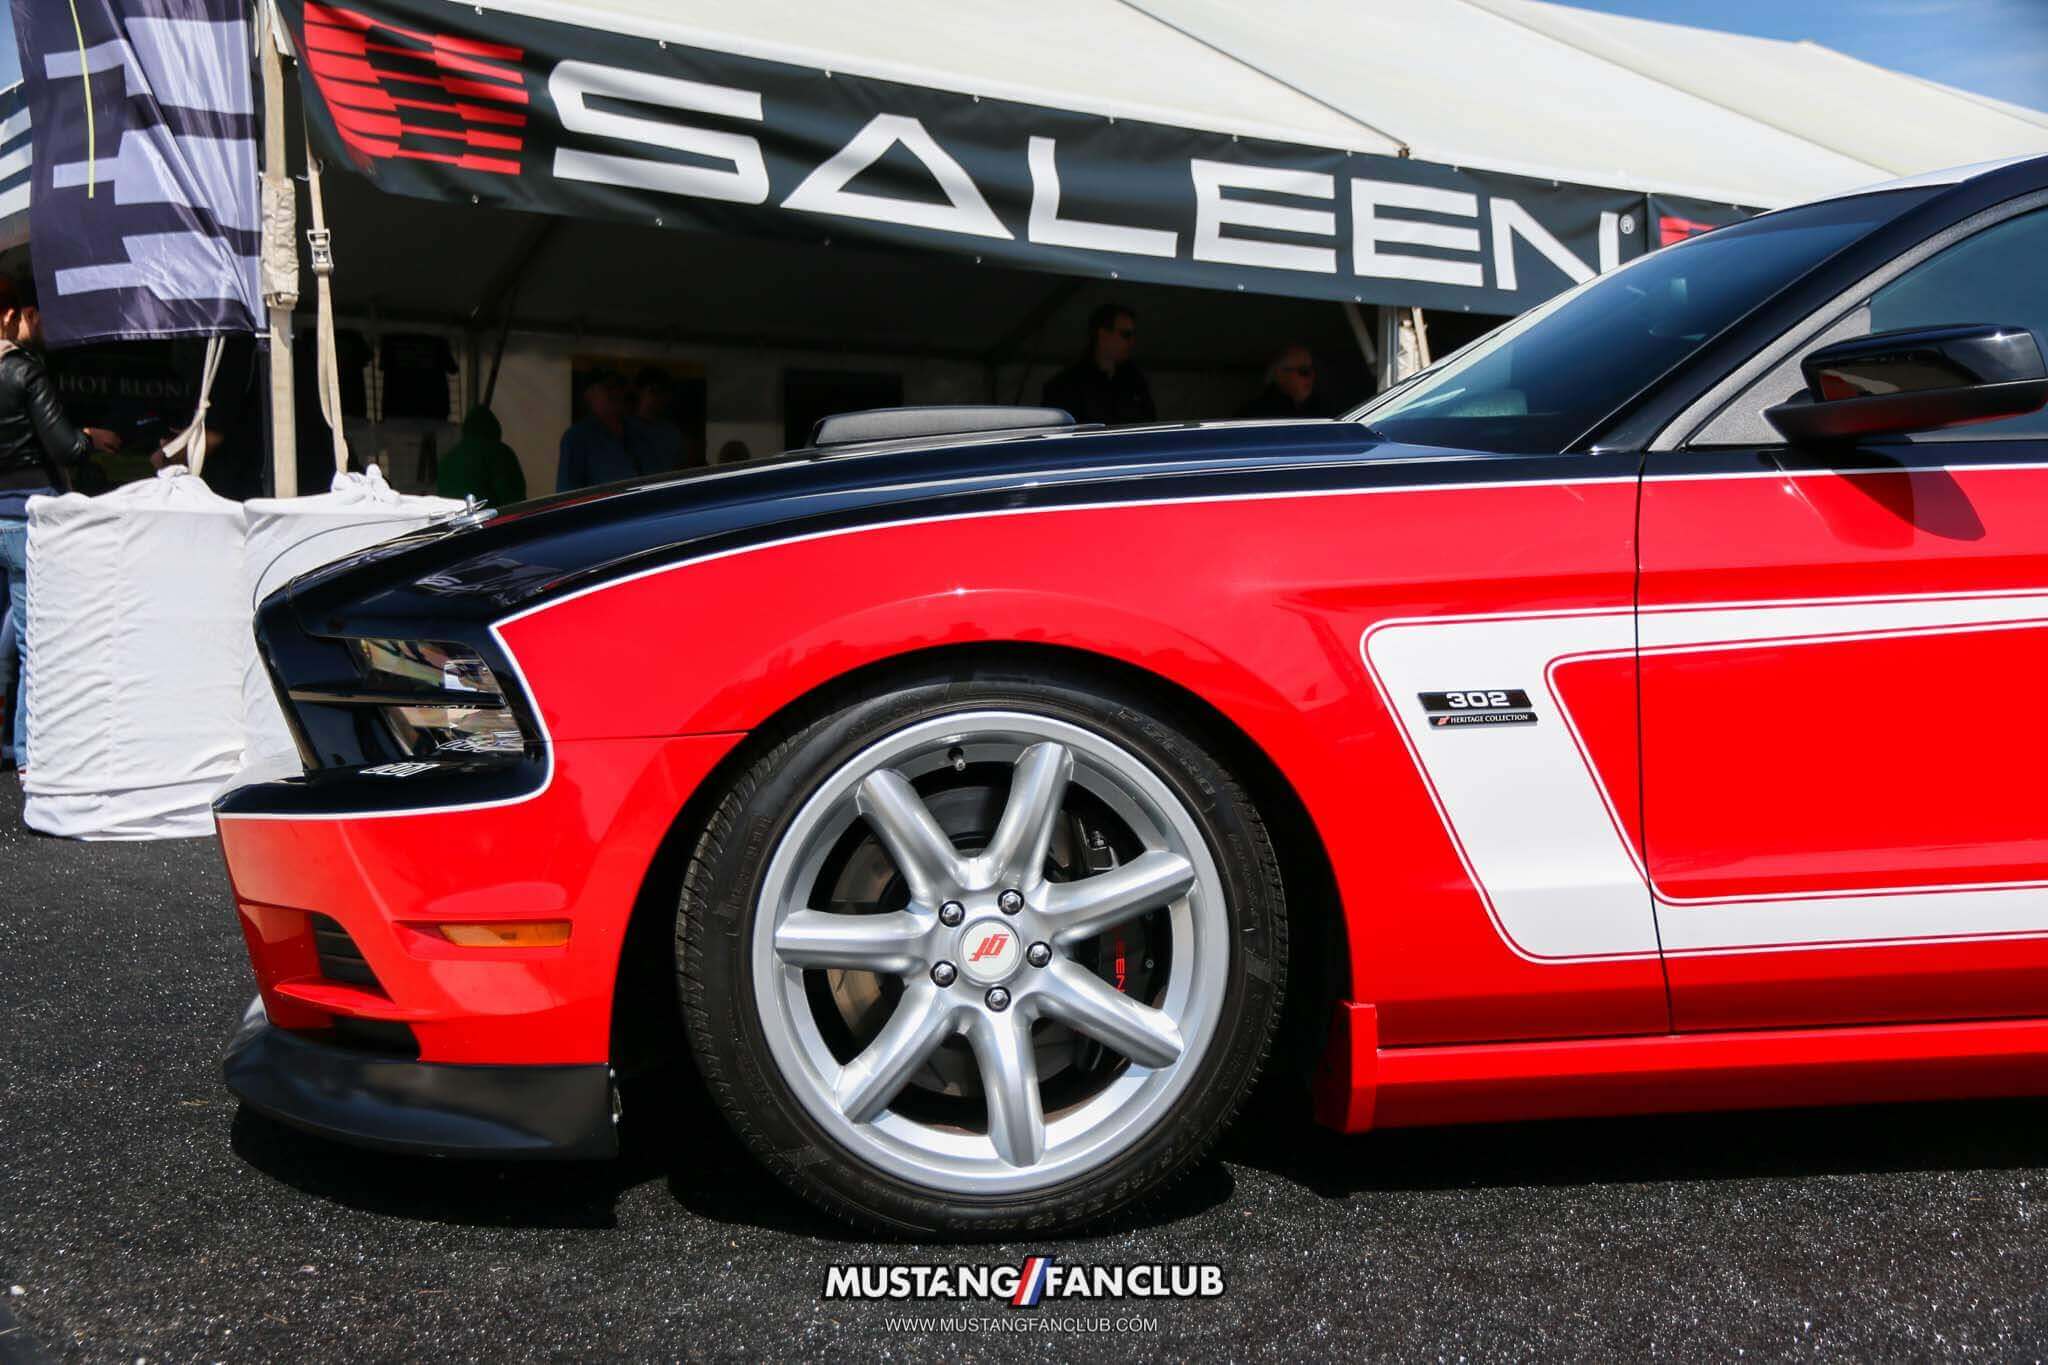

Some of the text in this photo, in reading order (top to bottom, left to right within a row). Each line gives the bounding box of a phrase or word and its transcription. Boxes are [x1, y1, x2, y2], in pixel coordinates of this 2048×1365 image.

[547, 59, 1619, 291] SALEEN
[57, 375, 112, 394] HOT
[1445, 691, 1511, 708] 302
[1450, 714, 1529, 724] HERITAGE COLLECTION
